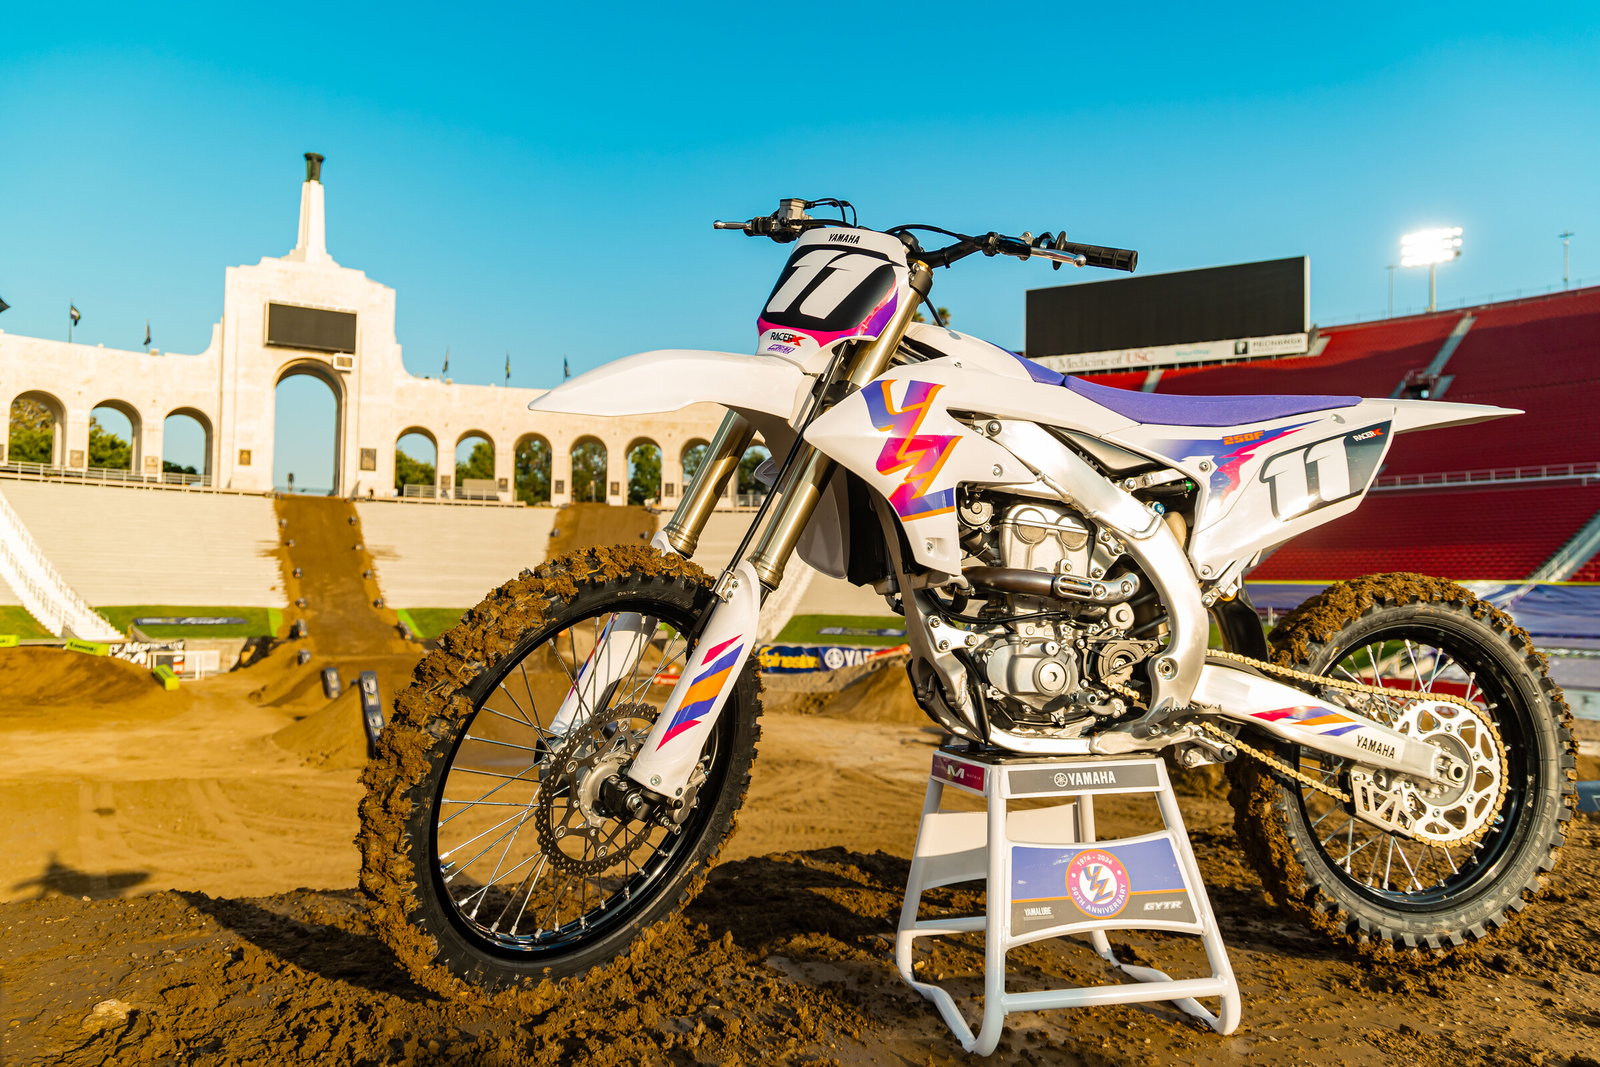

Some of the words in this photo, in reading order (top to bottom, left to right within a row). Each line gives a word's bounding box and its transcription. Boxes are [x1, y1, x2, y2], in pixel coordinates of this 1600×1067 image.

[828, 233, 860, 244] YAMAHA
[766, 249, 892, 320] 11
[1125, 350, 1154, 364] USC
[1223, 431, 1265, 446] 250F
[1261, 436, 1351, 522] 11
[1356, 734, 1395, 759] YAMAHA
[1068, 770, 1116, 786] YAMAHA
[1076, 854, 1092, 866] 1974
[1097, 854, 1113, 865] 2024
[1085, 883, 1126, 914] ANNIVERSARY
[1143, 901, 1183, 911] GYTR
[1023, 906, 1052, 917] YAMALUBE
